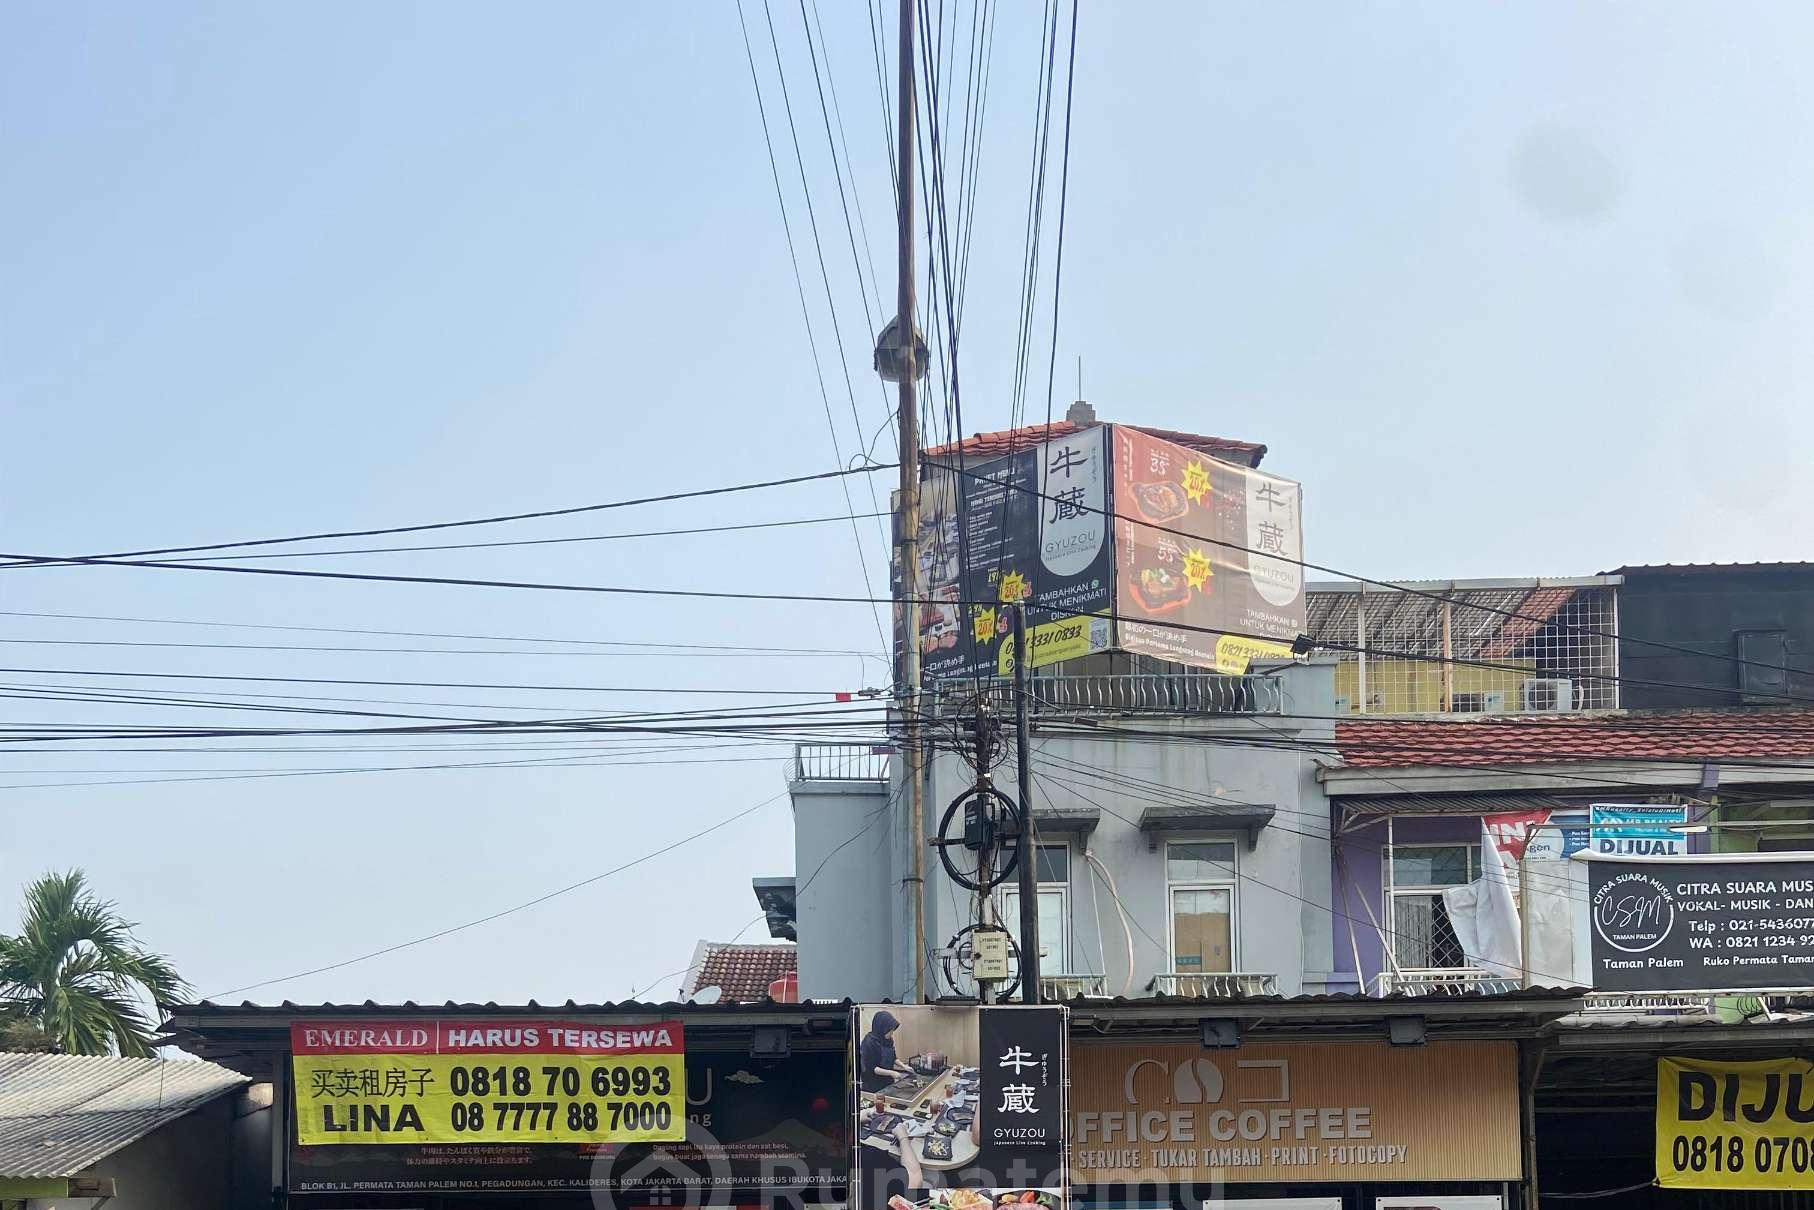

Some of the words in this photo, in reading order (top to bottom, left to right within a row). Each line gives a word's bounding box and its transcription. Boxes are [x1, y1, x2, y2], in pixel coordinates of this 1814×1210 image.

[1046, 529, 1096, 553] GYUZOU
[1036, 583, 1089, 600] AMBAHKAN
[1600, 838, 1679, 856] DIJUAL
[1593, 880, 1615, 904] CITRA
[1615, 873, 1648, 884] SUARA
[1650, 875, 1674, 903] MUSIK
[1676, 883, 1722, 896] CITRA
[1726, 881, 1777, 894] SUARA
[1730, 899, 1771, 911] MUSIK
[1688, 920, 1716, 934] Telp
[1689, 937, 1713, 949] WA
[1725, 936, 1759, 948] 0821
[1763, 935, 1796, 947] 1234
[1602, 958, 1644, 969] Taman
[1648, 957, 1684, 968] Palem
[1703, 957, 1730, 966] Ruko
[1733, 956, 1778, 965] Permata
[303, 1028, 428, 1048] EMERALD
[448, 1028, 540, 1048] HARUS
[547, 1028, 673, 1048] TERSEWA
[311, 1067, 435, 1098] 买卖租房子
[450, 1066, 532, 1097] 0818
[542, 1066, 581, 1097] 70
[591, 1066, 671, 1097] 6993
[997, 1046, 1040, 1114] 牛蔵
[323, 1104, 426, 1132] LINA
[451, 1102, 485, 1132] 08
[493, 1102, 559, 1132] 7777
[567, 1102, 599, 1132] 88
[607, 1101, 672, 1132] 7000
[1208, 1107, 1373, 1142] COFFEE
[993, 1128, 1046, 1138] GYUZOU
[1078, 1149, 1142, 1168] SERVICE
[1151, 1149, 1198, 1168] TUKAR
[1202, 1148, 1261, 1167] TAMBAH
[1271, 1146, 1320, 1165] PRINT
[1328, 1145, 1408, 1165] FOTOCOPY
[1672, 1135, 1745, 1173] 0818
[1754, 1136, 1814, 1173] 070
[353, 1182, 394, 1190] PERMATA
[428, 1181, 458, 1189] PALEM
[620, 1178, 643, 1186] KOTA
[752, 1176, 788, 1184] KHUSUS
